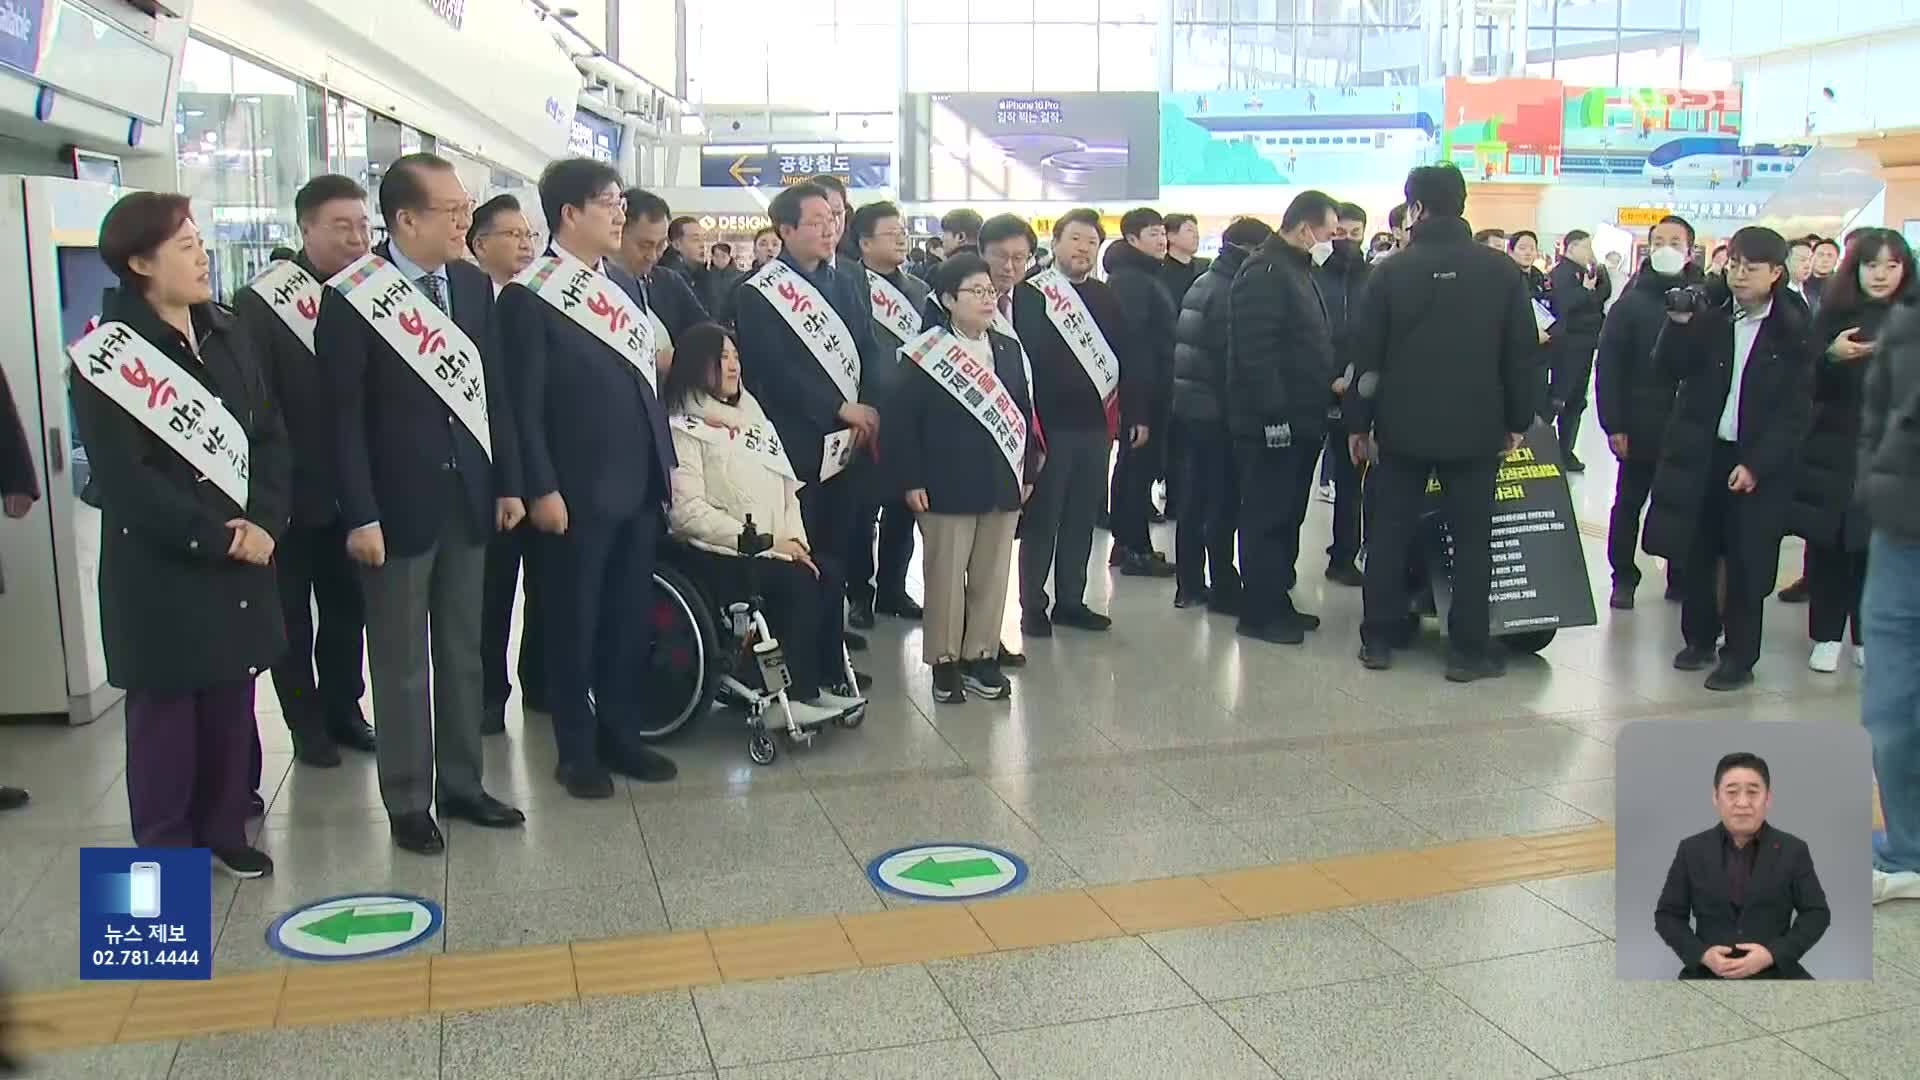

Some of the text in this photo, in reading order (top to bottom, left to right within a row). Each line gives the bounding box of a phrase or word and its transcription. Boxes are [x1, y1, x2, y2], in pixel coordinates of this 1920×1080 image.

[1006, 100, 1033, 111] iPhone
[1045, 101, 1059, 110] Pro
[779, 155, 850, 173] 공항철도
[718, 215, 772, 230] DESIGN
[272, 271, 311, 307] 새해
[561, 268, 594, 311] 새해
[586, 290, 631, 333] 복
[777, 280, 812, 313] 복
[1043, 285, 1072, 312] 복
[371, 279, 414, 321] 새해
[398, 307, 447, 356] 복
[434, 349, 471, 388] 많이
[88, 327, 132, 377] 새해
[120, 357, 178, 409] 복
[169, 399, 206, 440] 많이
[932, 358, 985, 409] 경제를
